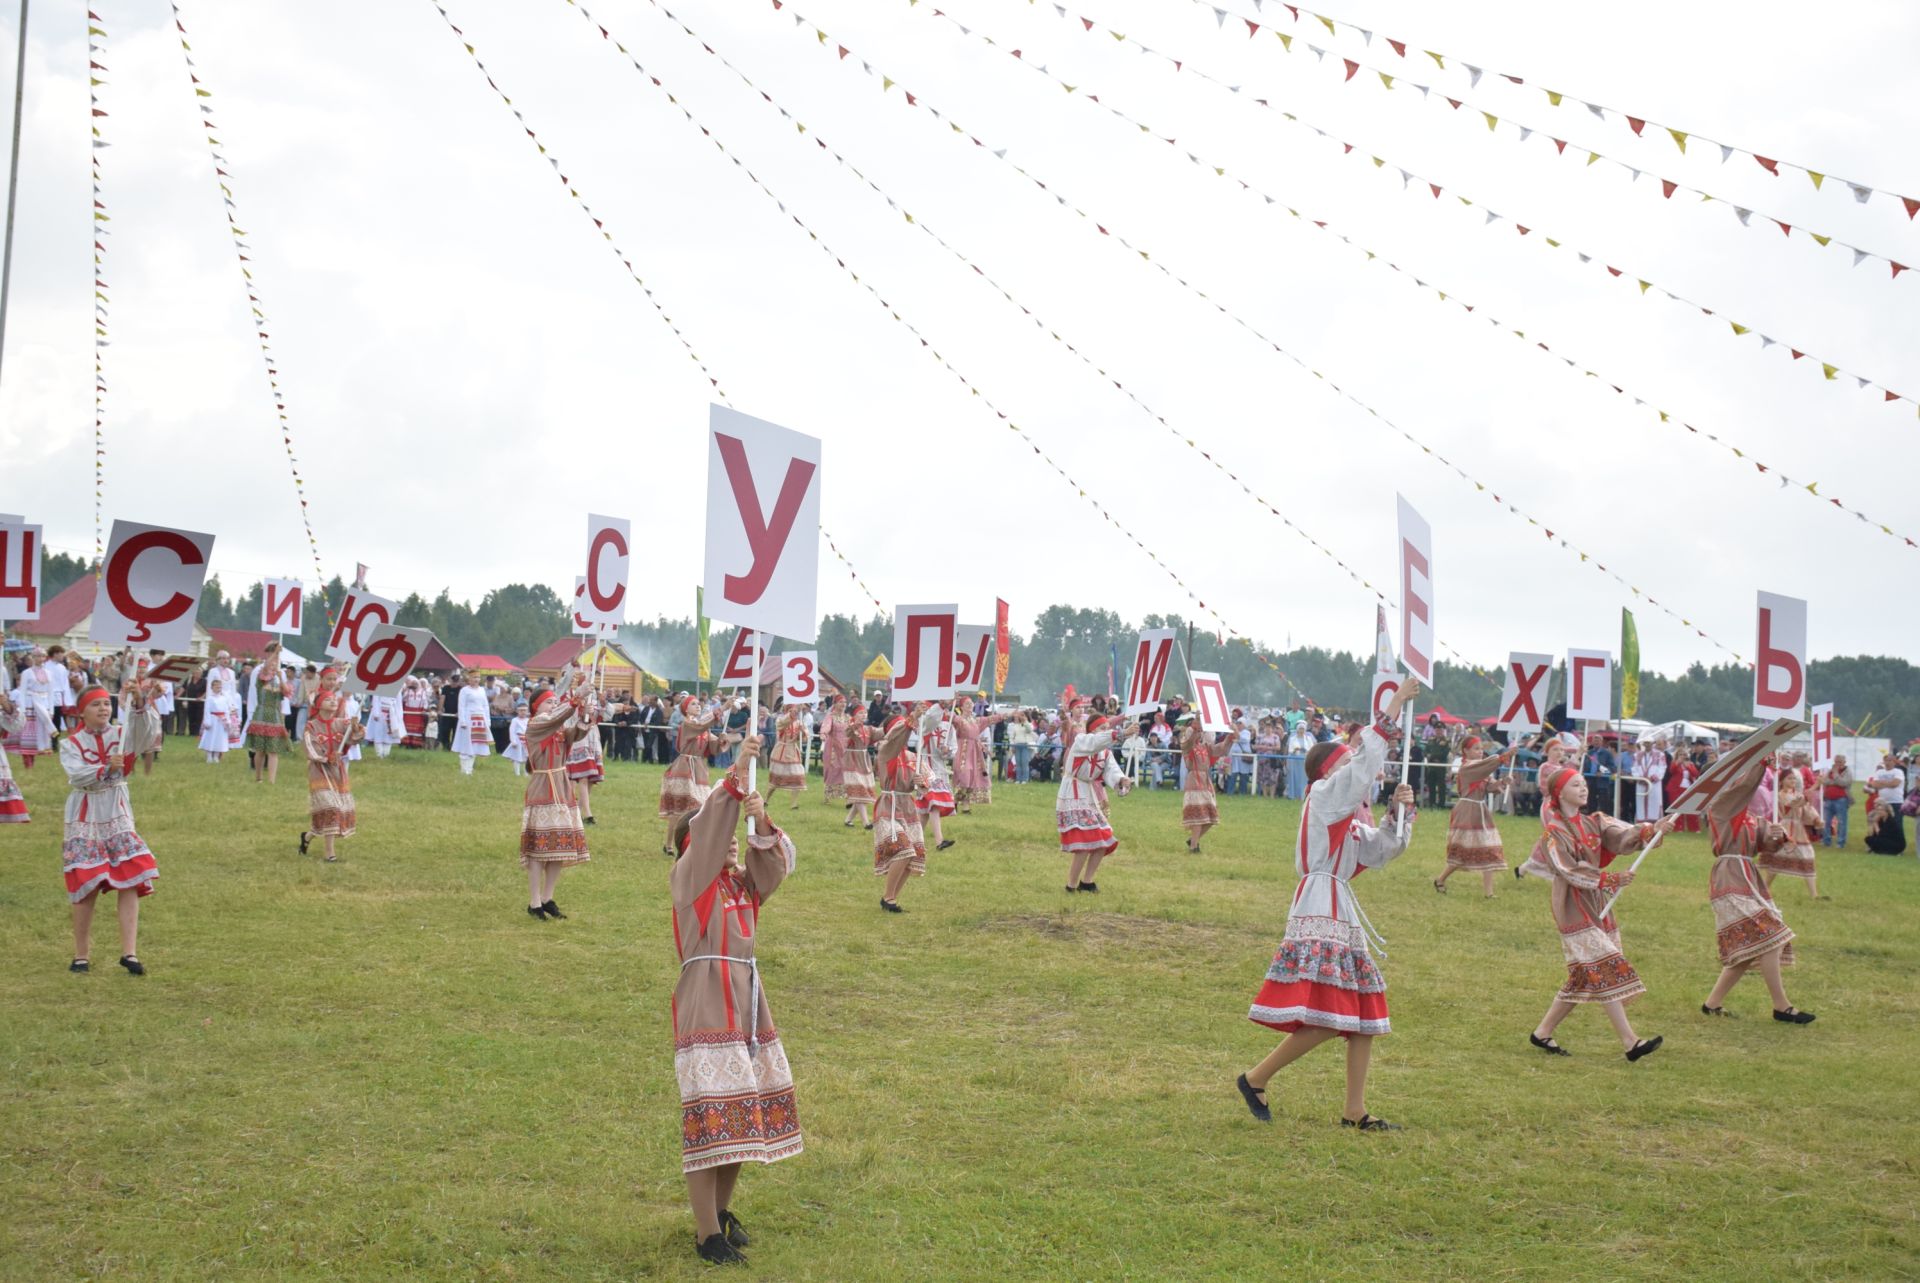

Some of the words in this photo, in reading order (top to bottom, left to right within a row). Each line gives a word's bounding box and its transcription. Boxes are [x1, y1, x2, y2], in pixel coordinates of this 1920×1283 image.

[714, 432, 816, 605] У
[588, 528, 628, 612] С
[266, 584, 301, 629] И
[330, 594, 389, 656] Ю
[1403, 537, 1429, 680] Е
[356, 633, 416, 691] Ф
[723, 627, 765, 679] Б
[894, 614, 955, 688] Л
[1129, 638, 1173, 706] М
[1756, 608, 1803, 709] Ь
[1195, 678, 1230, 725] П
[1501, 662, 1547, 725] Х
[1573, 656, 1605, 710] Г
[1813, 711, 1831, 762] Н
